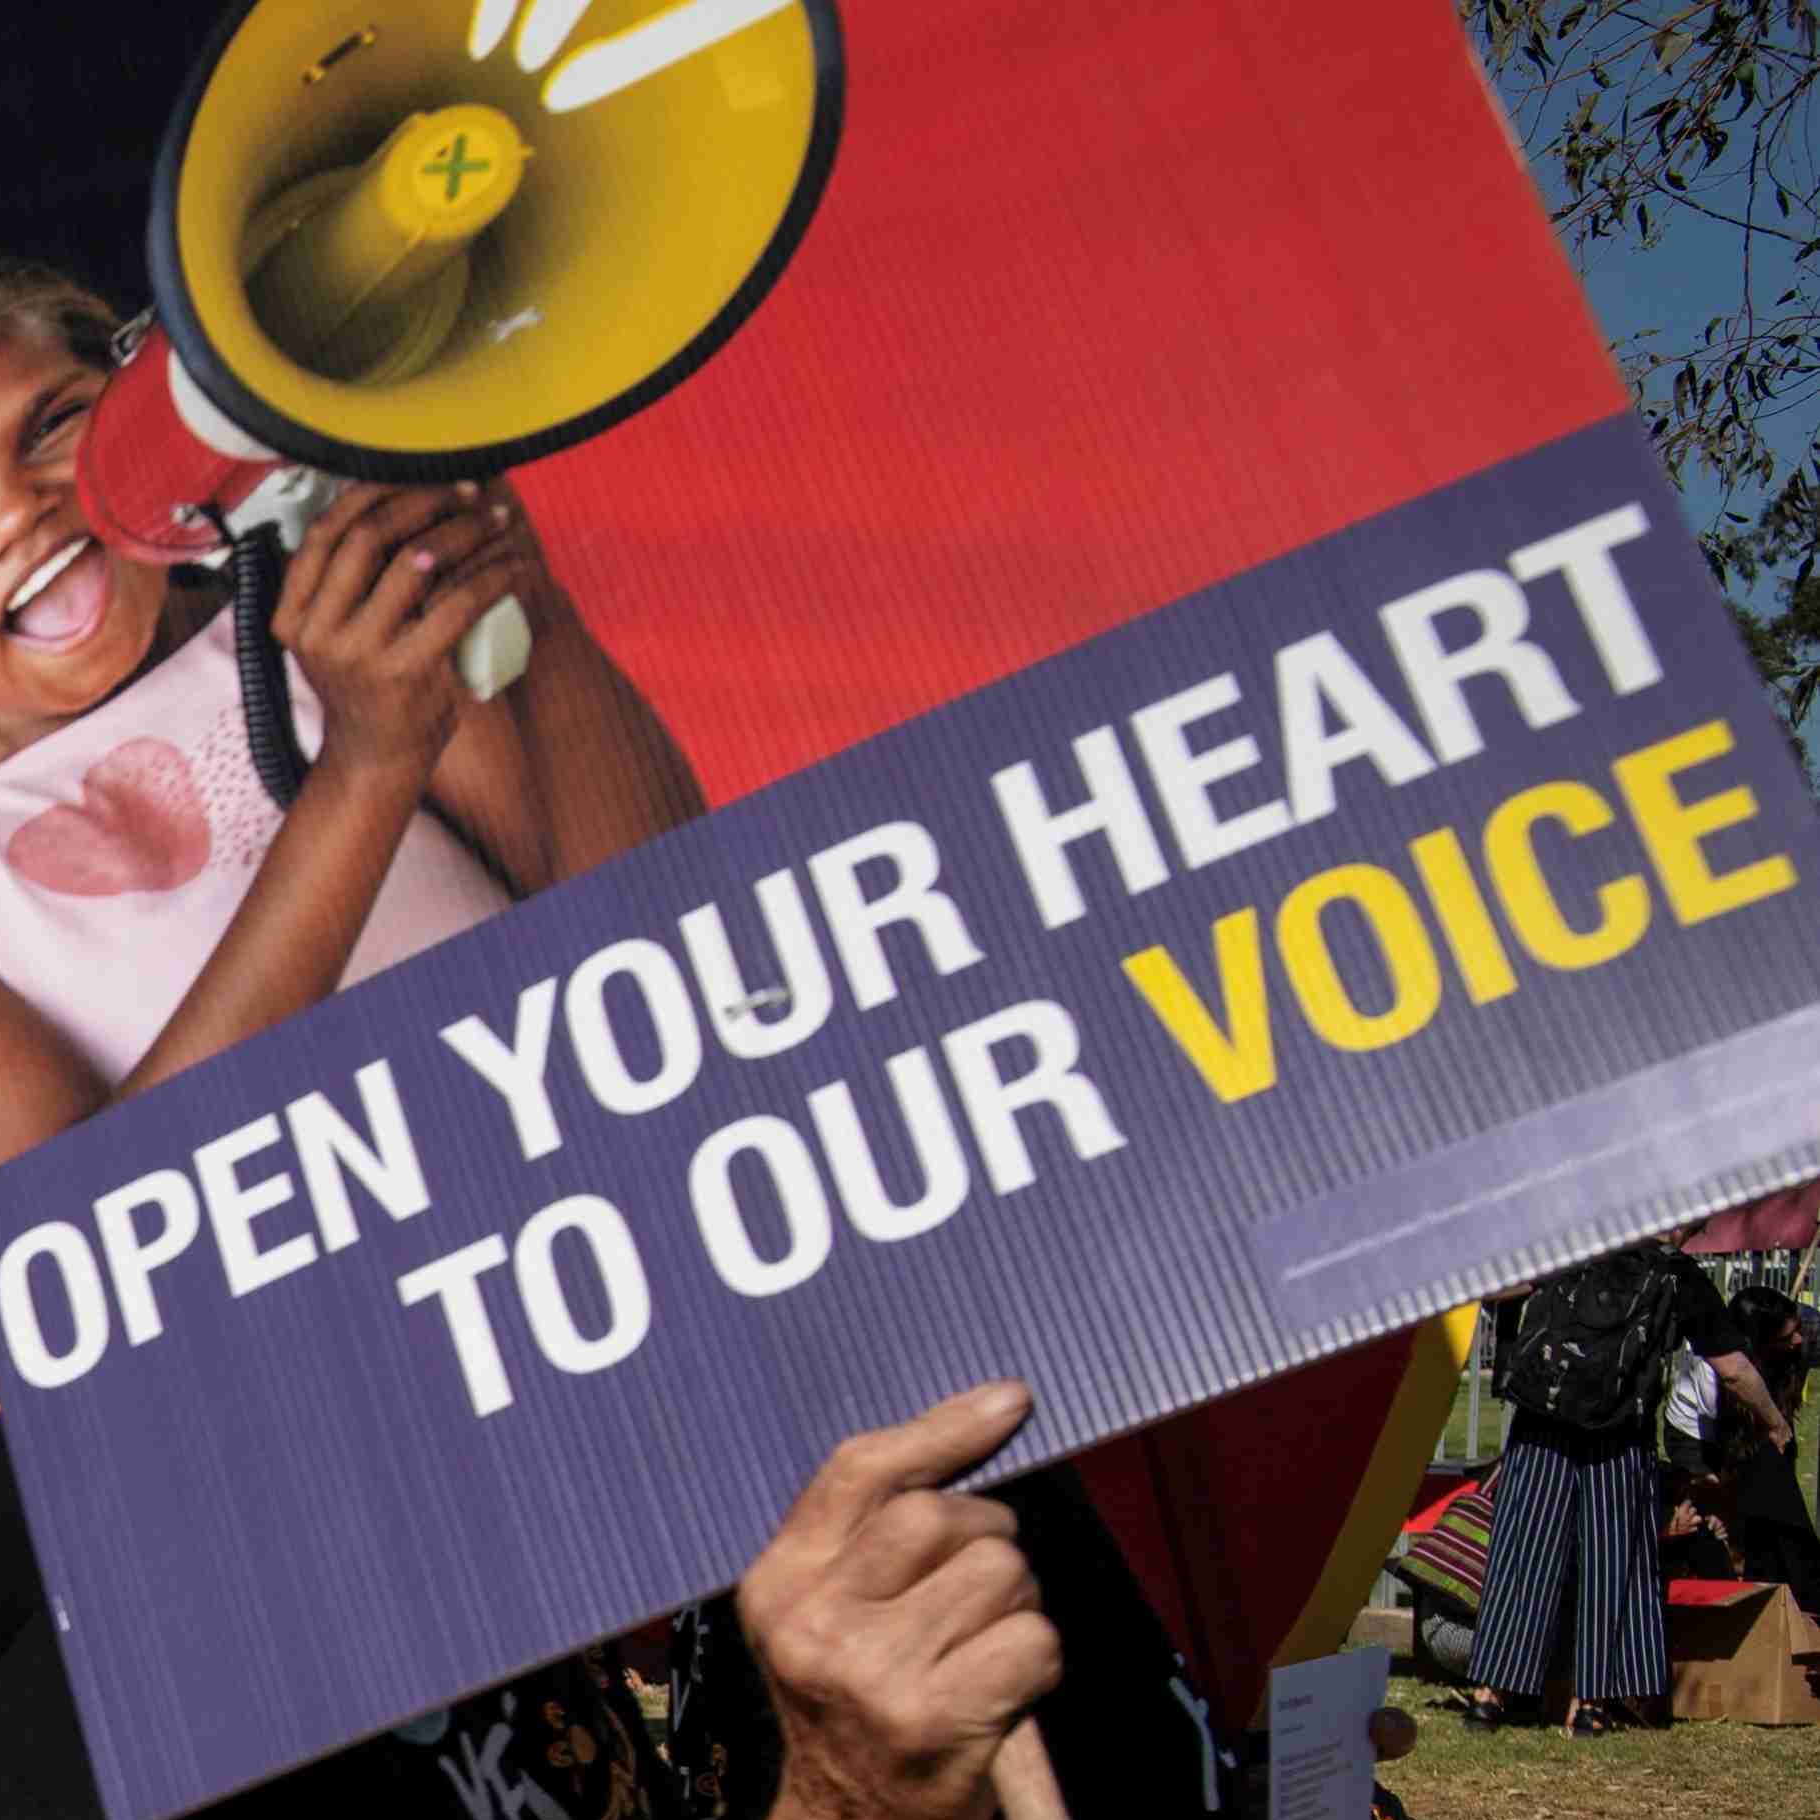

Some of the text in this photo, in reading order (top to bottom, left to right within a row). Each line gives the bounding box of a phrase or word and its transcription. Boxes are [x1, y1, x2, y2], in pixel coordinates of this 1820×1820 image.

[397, 721, 1795, 1417] TO OUR VOICE
[440, 821, 983, 1160] YOUR
[991, 507, 1659, 929] HEART
